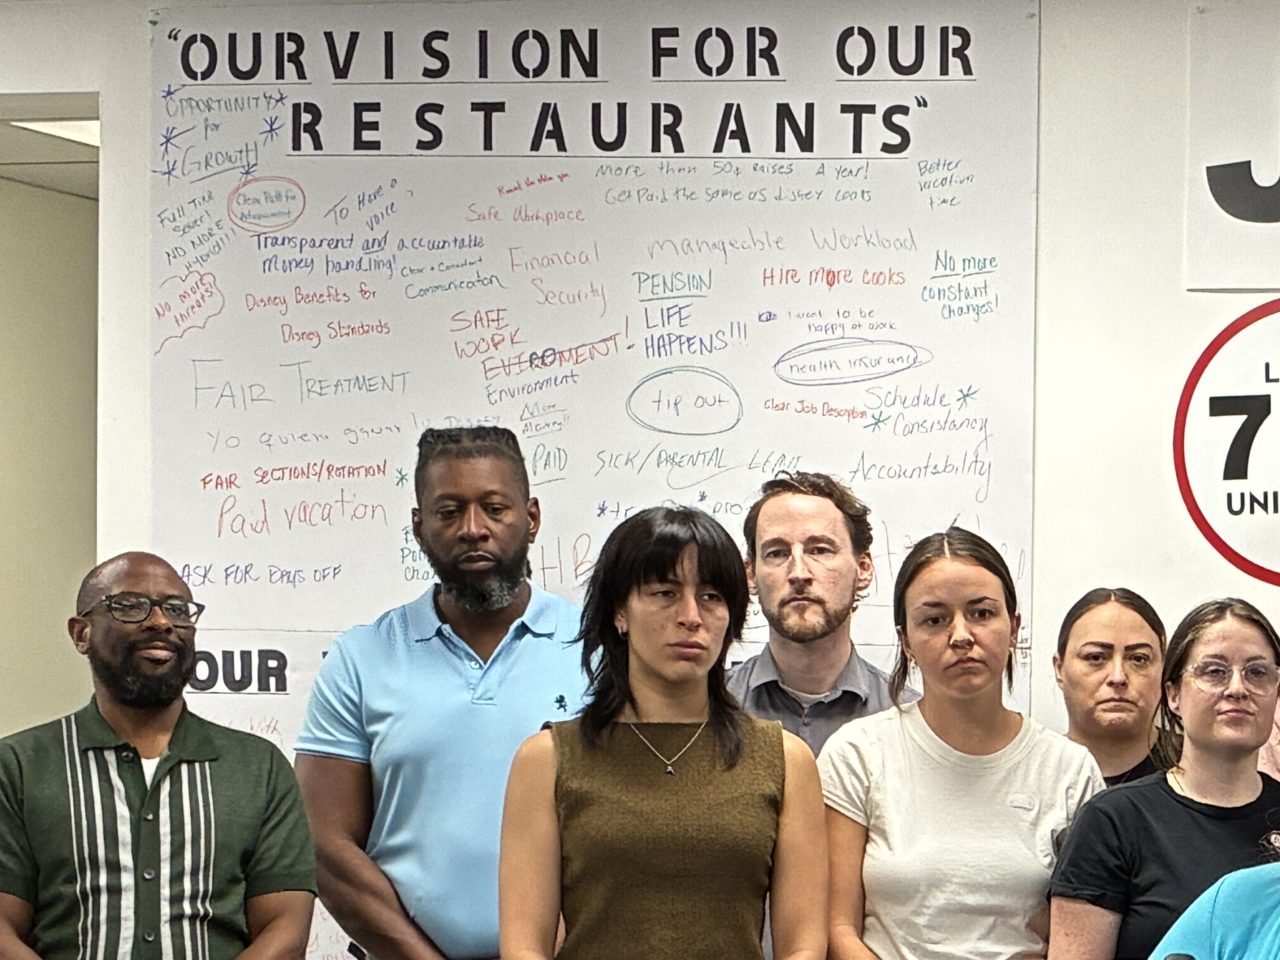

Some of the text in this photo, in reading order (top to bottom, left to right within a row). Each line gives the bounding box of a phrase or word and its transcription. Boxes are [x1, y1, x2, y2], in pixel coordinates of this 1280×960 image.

[651, 26, 780, 78] FOR
[835, 25, 975, 77] OUR
[187, 648, 288, 693] OUR
